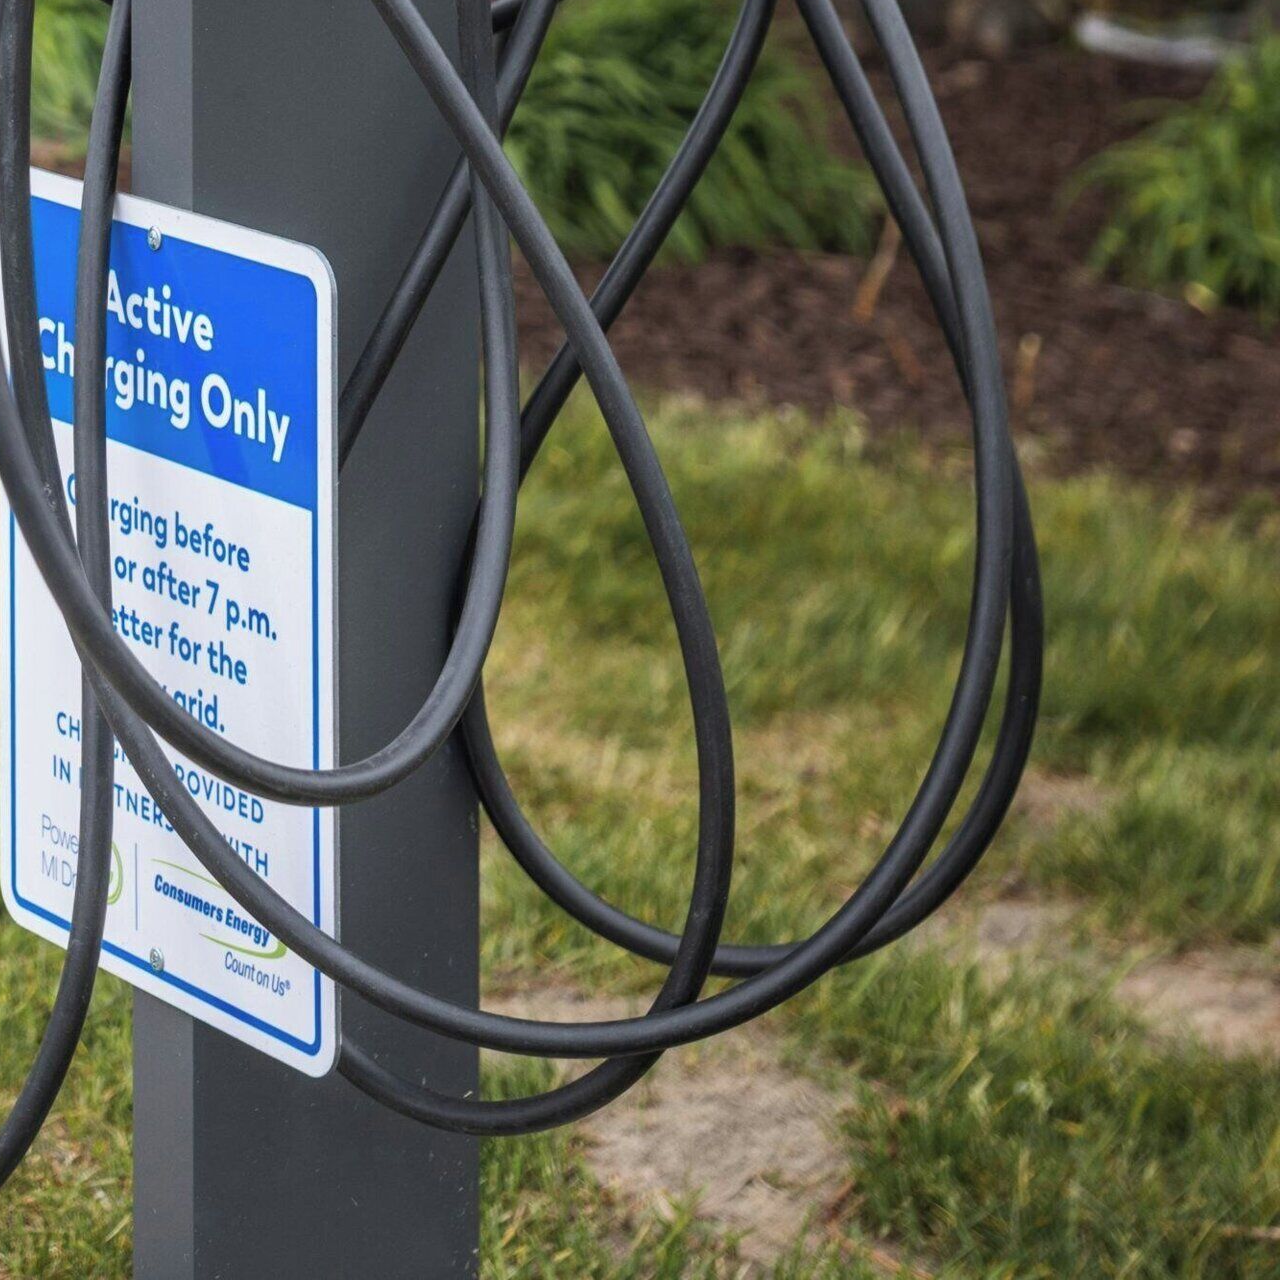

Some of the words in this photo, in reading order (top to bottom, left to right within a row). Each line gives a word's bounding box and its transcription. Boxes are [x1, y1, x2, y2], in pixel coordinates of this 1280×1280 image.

[106, 269, 214, 352] Active
[38, 317, 190, 430] Chrging
[200, 373, 291, 463] Only
[175, 511, 250, 572] before
[114, 555, 137, 583] or
[142, 561, 201, 608] after
[205, 579, 219, 615] 7
[226, 597, 278, 641] p.m.
[112, 604, 163, 649] etter
[168, 621, 202, 665] for
[207, 641, 247, 685] the
[52, 754, 71, 784] IN
[154, 873, 224, 923] Consumers
[225, 907, 270, 948] Energy
[224, 951, 255, 982] Count
[256, 970, 270, 989] on
